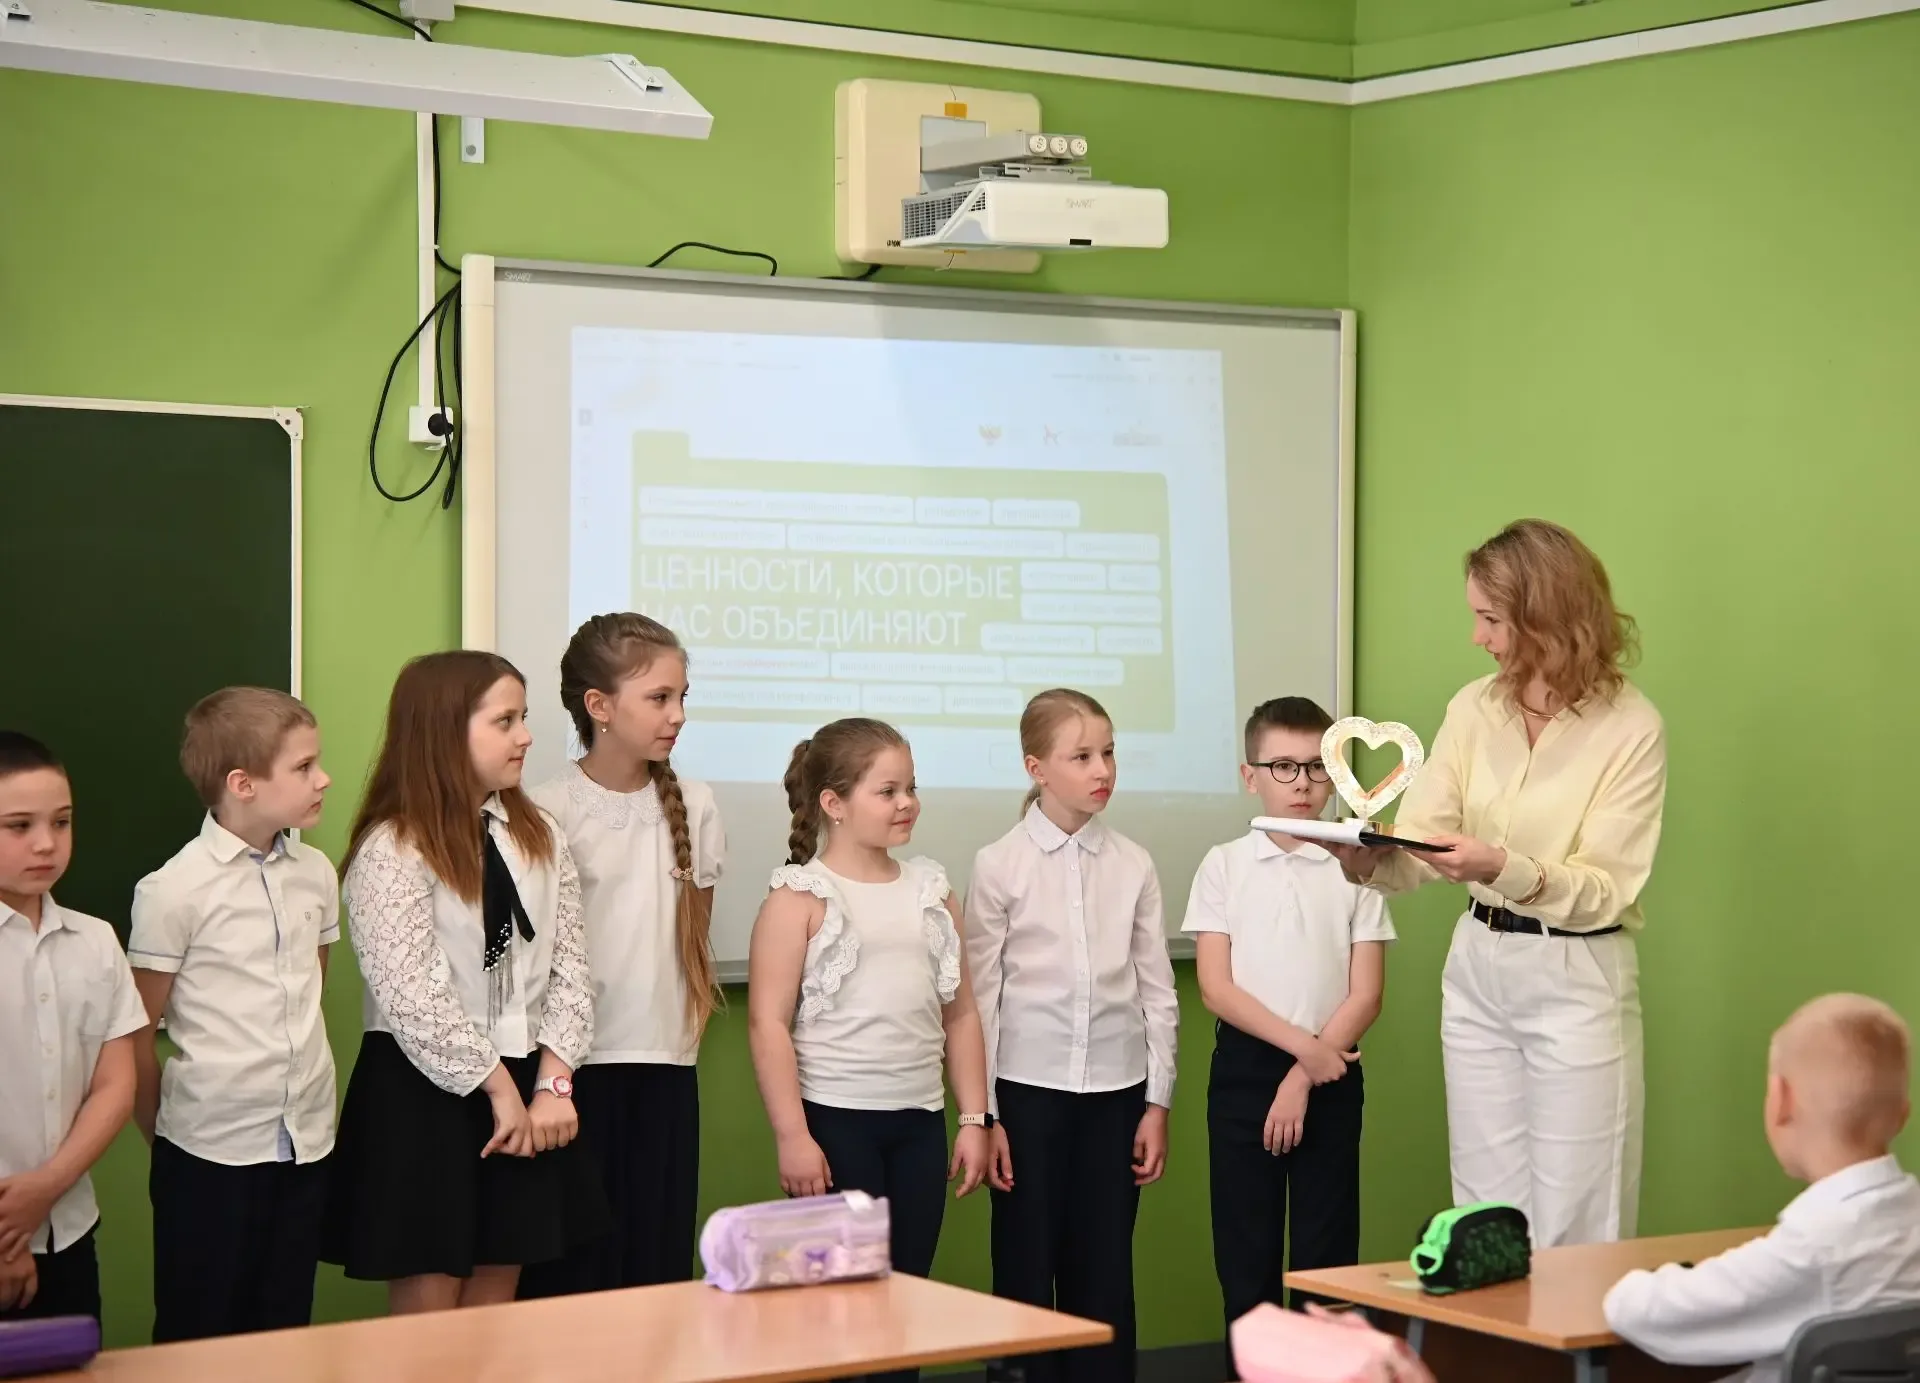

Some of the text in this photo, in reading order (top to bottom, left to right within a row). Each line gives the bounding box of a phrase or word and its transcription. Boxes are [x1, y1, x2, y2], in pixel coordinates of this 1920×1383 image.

[639, 555, 1014, 600] ЦЕННОСТИ, КОТОРЫЕ
[723, 606, 967, 648] ОБЪЕДИНЯЮТ
